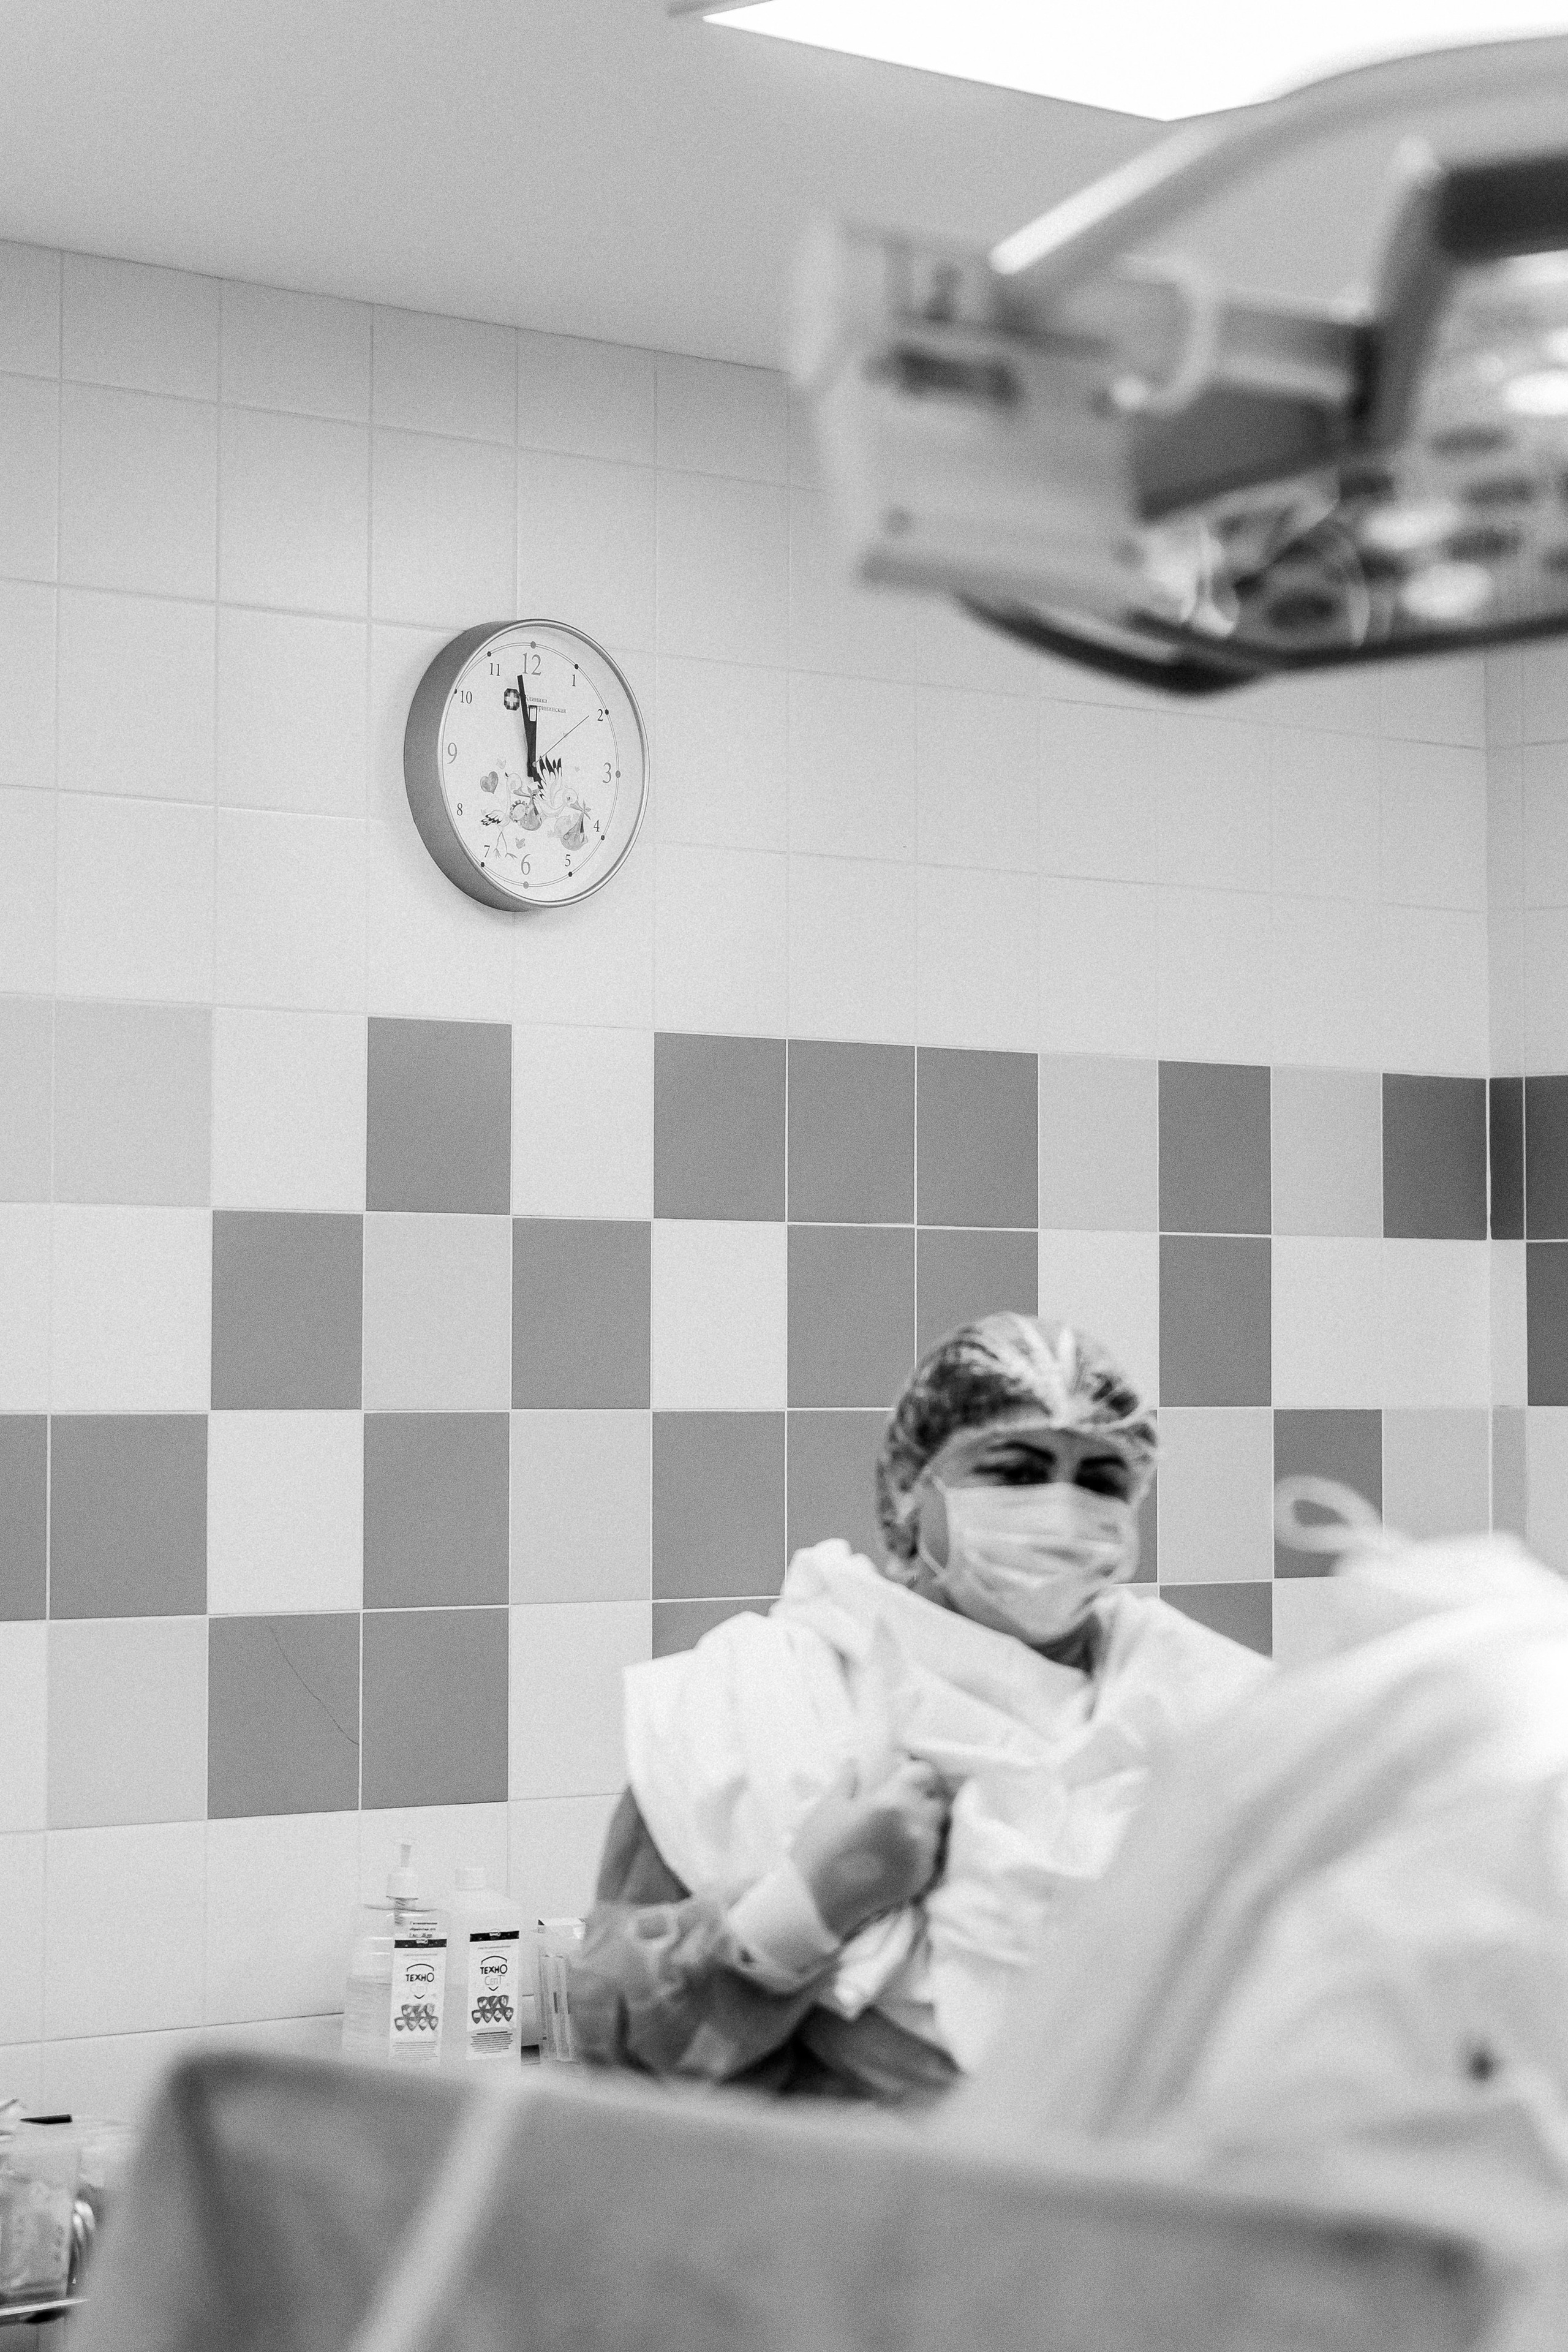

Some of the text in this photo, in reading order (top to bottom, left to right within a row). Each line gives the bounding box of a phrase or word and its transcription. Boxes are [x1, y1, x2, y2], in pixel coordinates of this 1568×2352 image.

[489, 662, 500, 676] 11
[521, 653, 541, 676] 12
[571, 674, 577, 687] 1
[460, 690, 473, 704] 10
[597, 708, 604, 722] 2
[447, 742, 458, 764] 9
[602, 762, 612, 783] 3
[456, 802, 463, 816] 8
[593, 820, 600, 832] 4
[484, 845, 491, 858] 7
[521, 853, 531, 875] 6
[565, 854, 571, 867] 5
[480, 1964, 508, 1975] ТЕХНО
[405, 1972, 434, 1983] ТЕХНО
